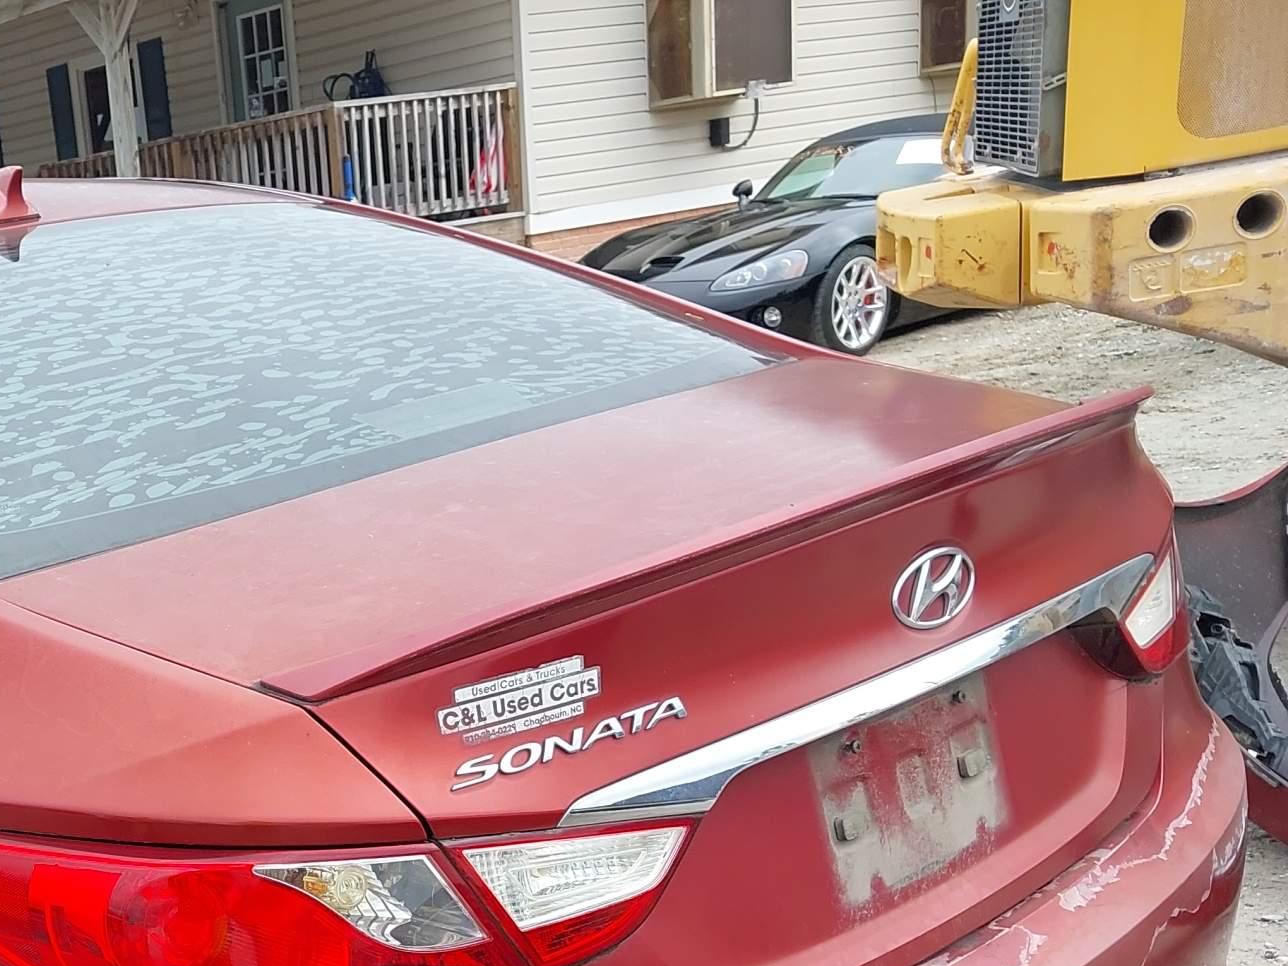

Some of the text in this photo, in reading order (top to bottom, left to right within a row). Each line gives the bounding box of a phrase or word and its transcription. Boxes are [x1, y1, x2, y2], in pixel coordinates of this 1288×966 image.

[471, 664, 566, 698] Used Cars & Trucks
[442, 677, 597, 731] C&L Used Cars
[570, 704, 582, 715] NC
[450, 696, 688, 792] SONATA
